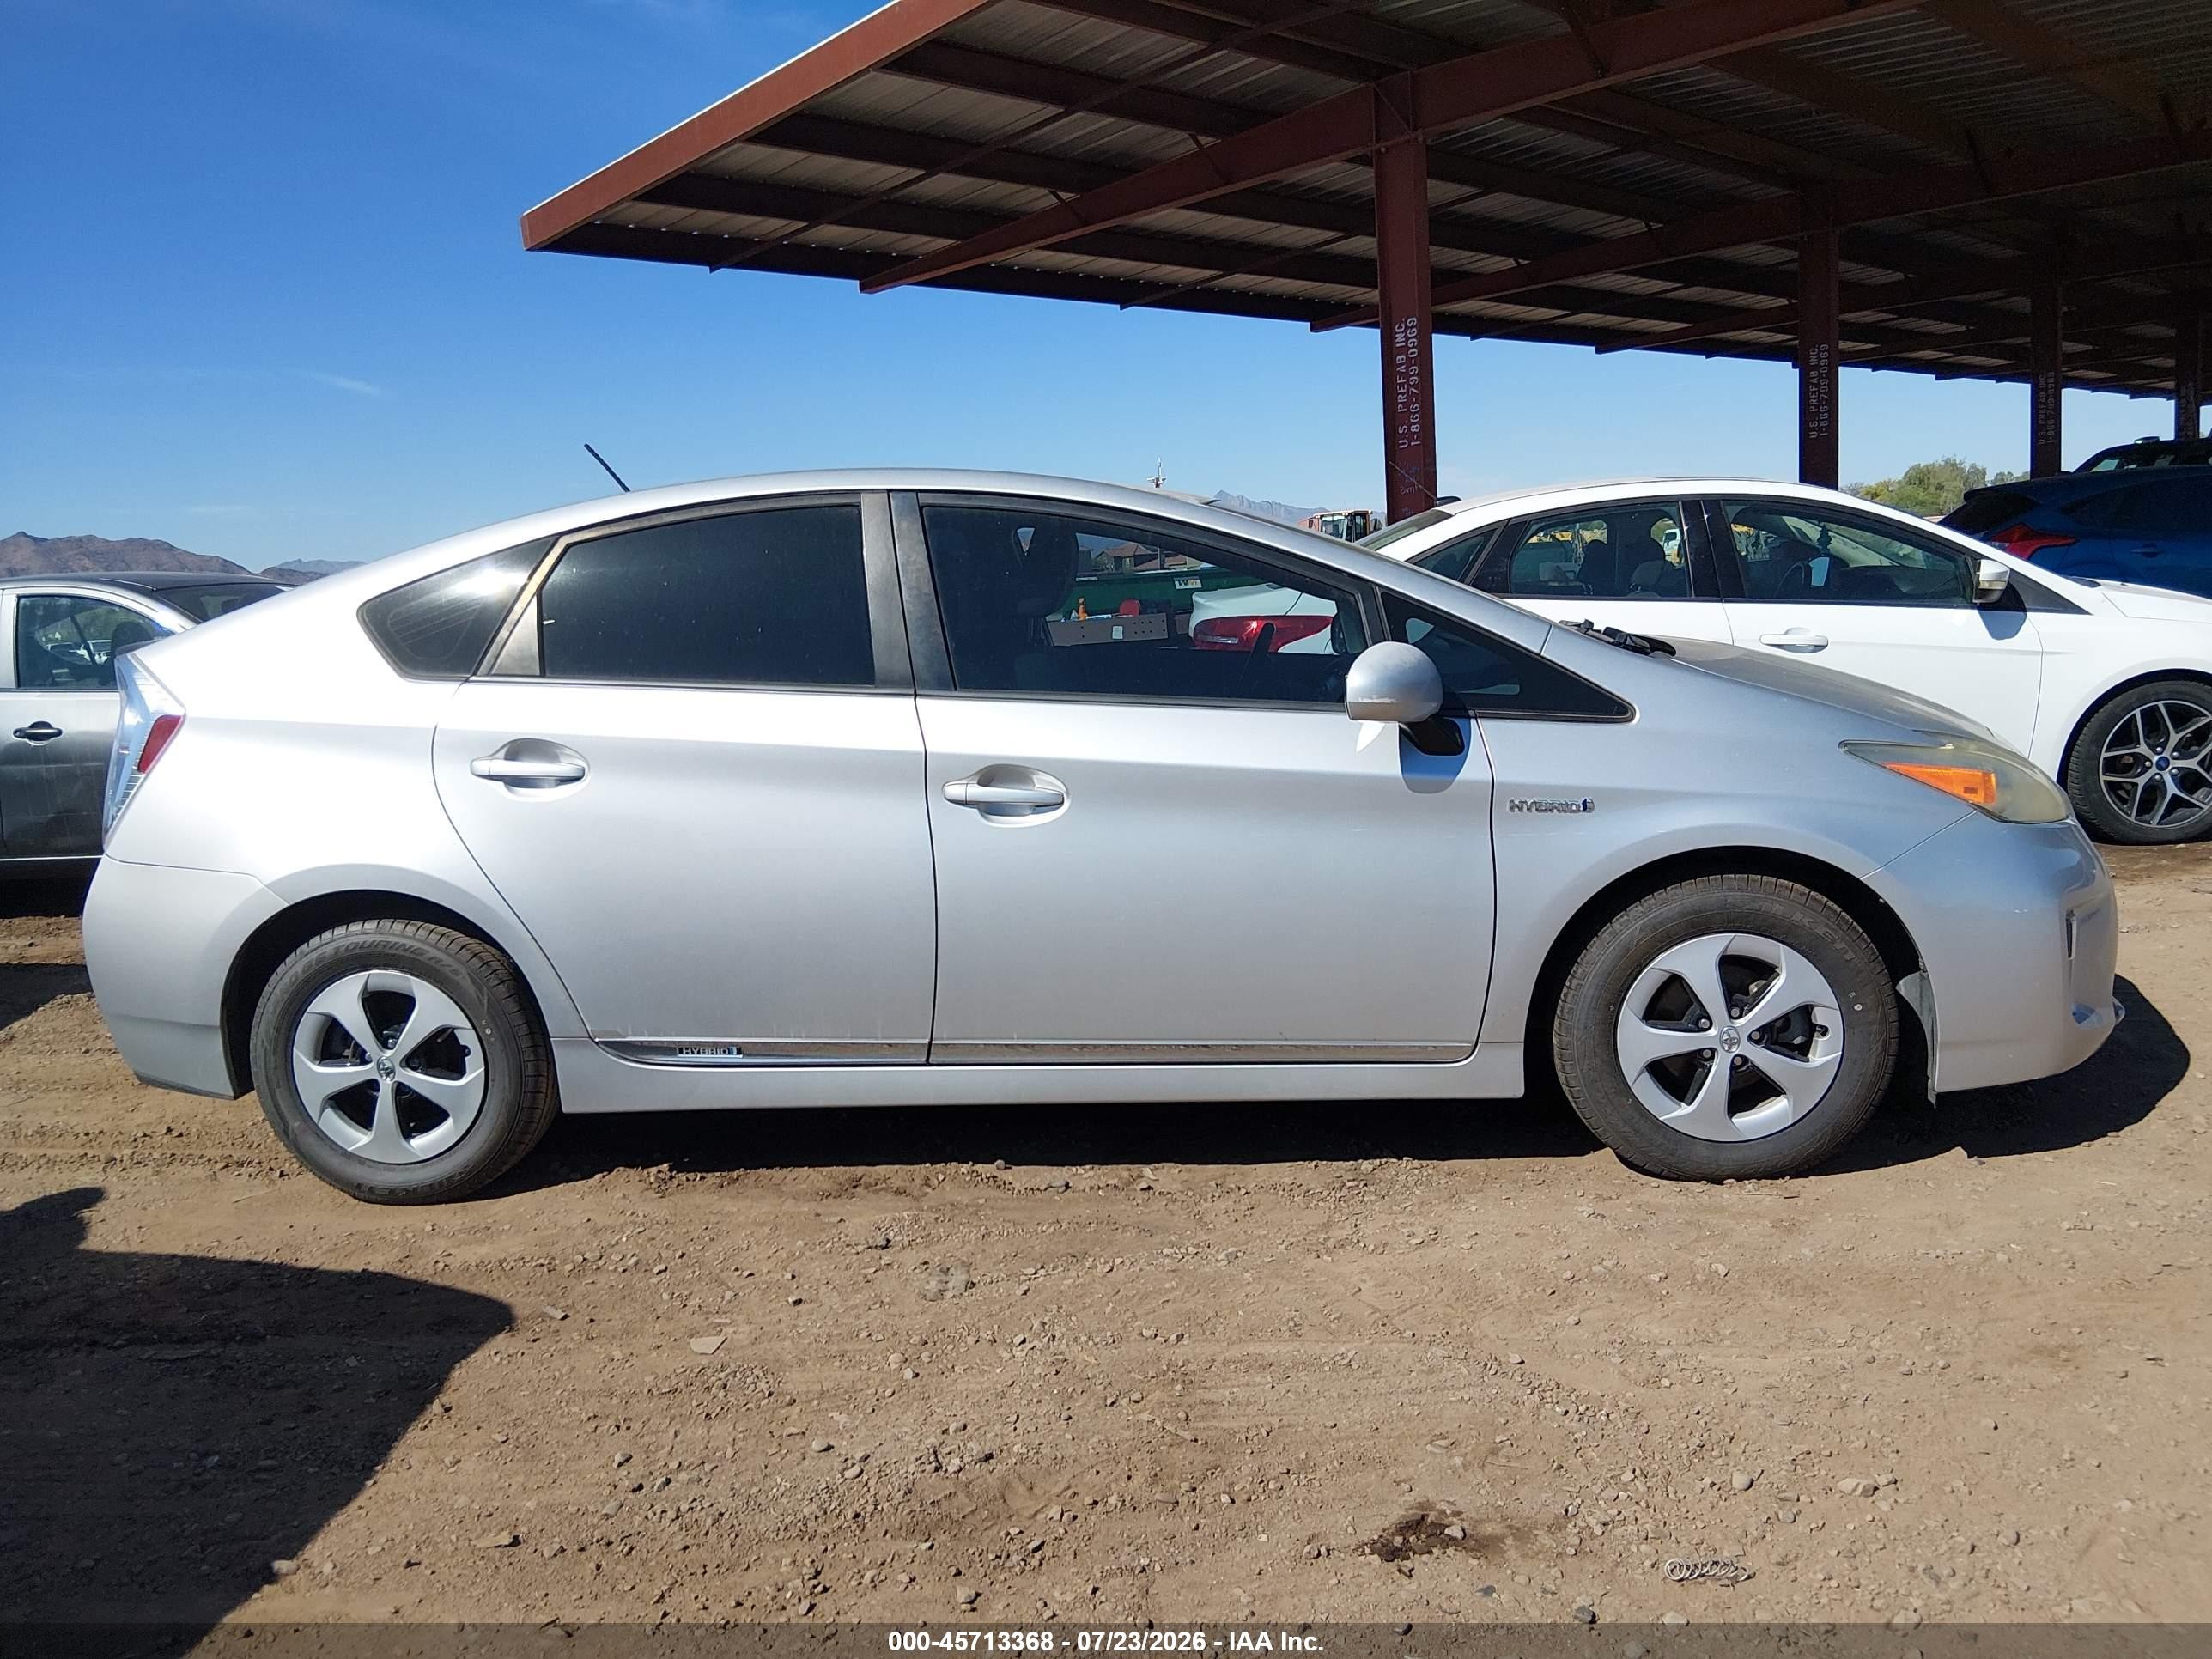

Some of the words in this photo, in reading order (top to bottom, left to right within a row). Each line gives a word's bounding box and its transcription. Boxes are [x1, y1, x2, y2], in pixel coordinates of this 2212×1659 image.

[1395, 318, 1406, 347] INC.
[1809, 344, 1819, 366] INC.
[1396, 355, 1407, 412] PREFAB
[1407, 317, 1421, 447] 1-866-799-0969
[1809, 371, 1819, 412] PREFAB
[1398, 420, 1409, 448] U.S.
[1809, 418, 1819, 438] U.S.
[1509, 799, 1581, 813] HYBRID
[331, 939, 430, 957] TOURING
[683, 1047, 729, 1056] HYBRID
